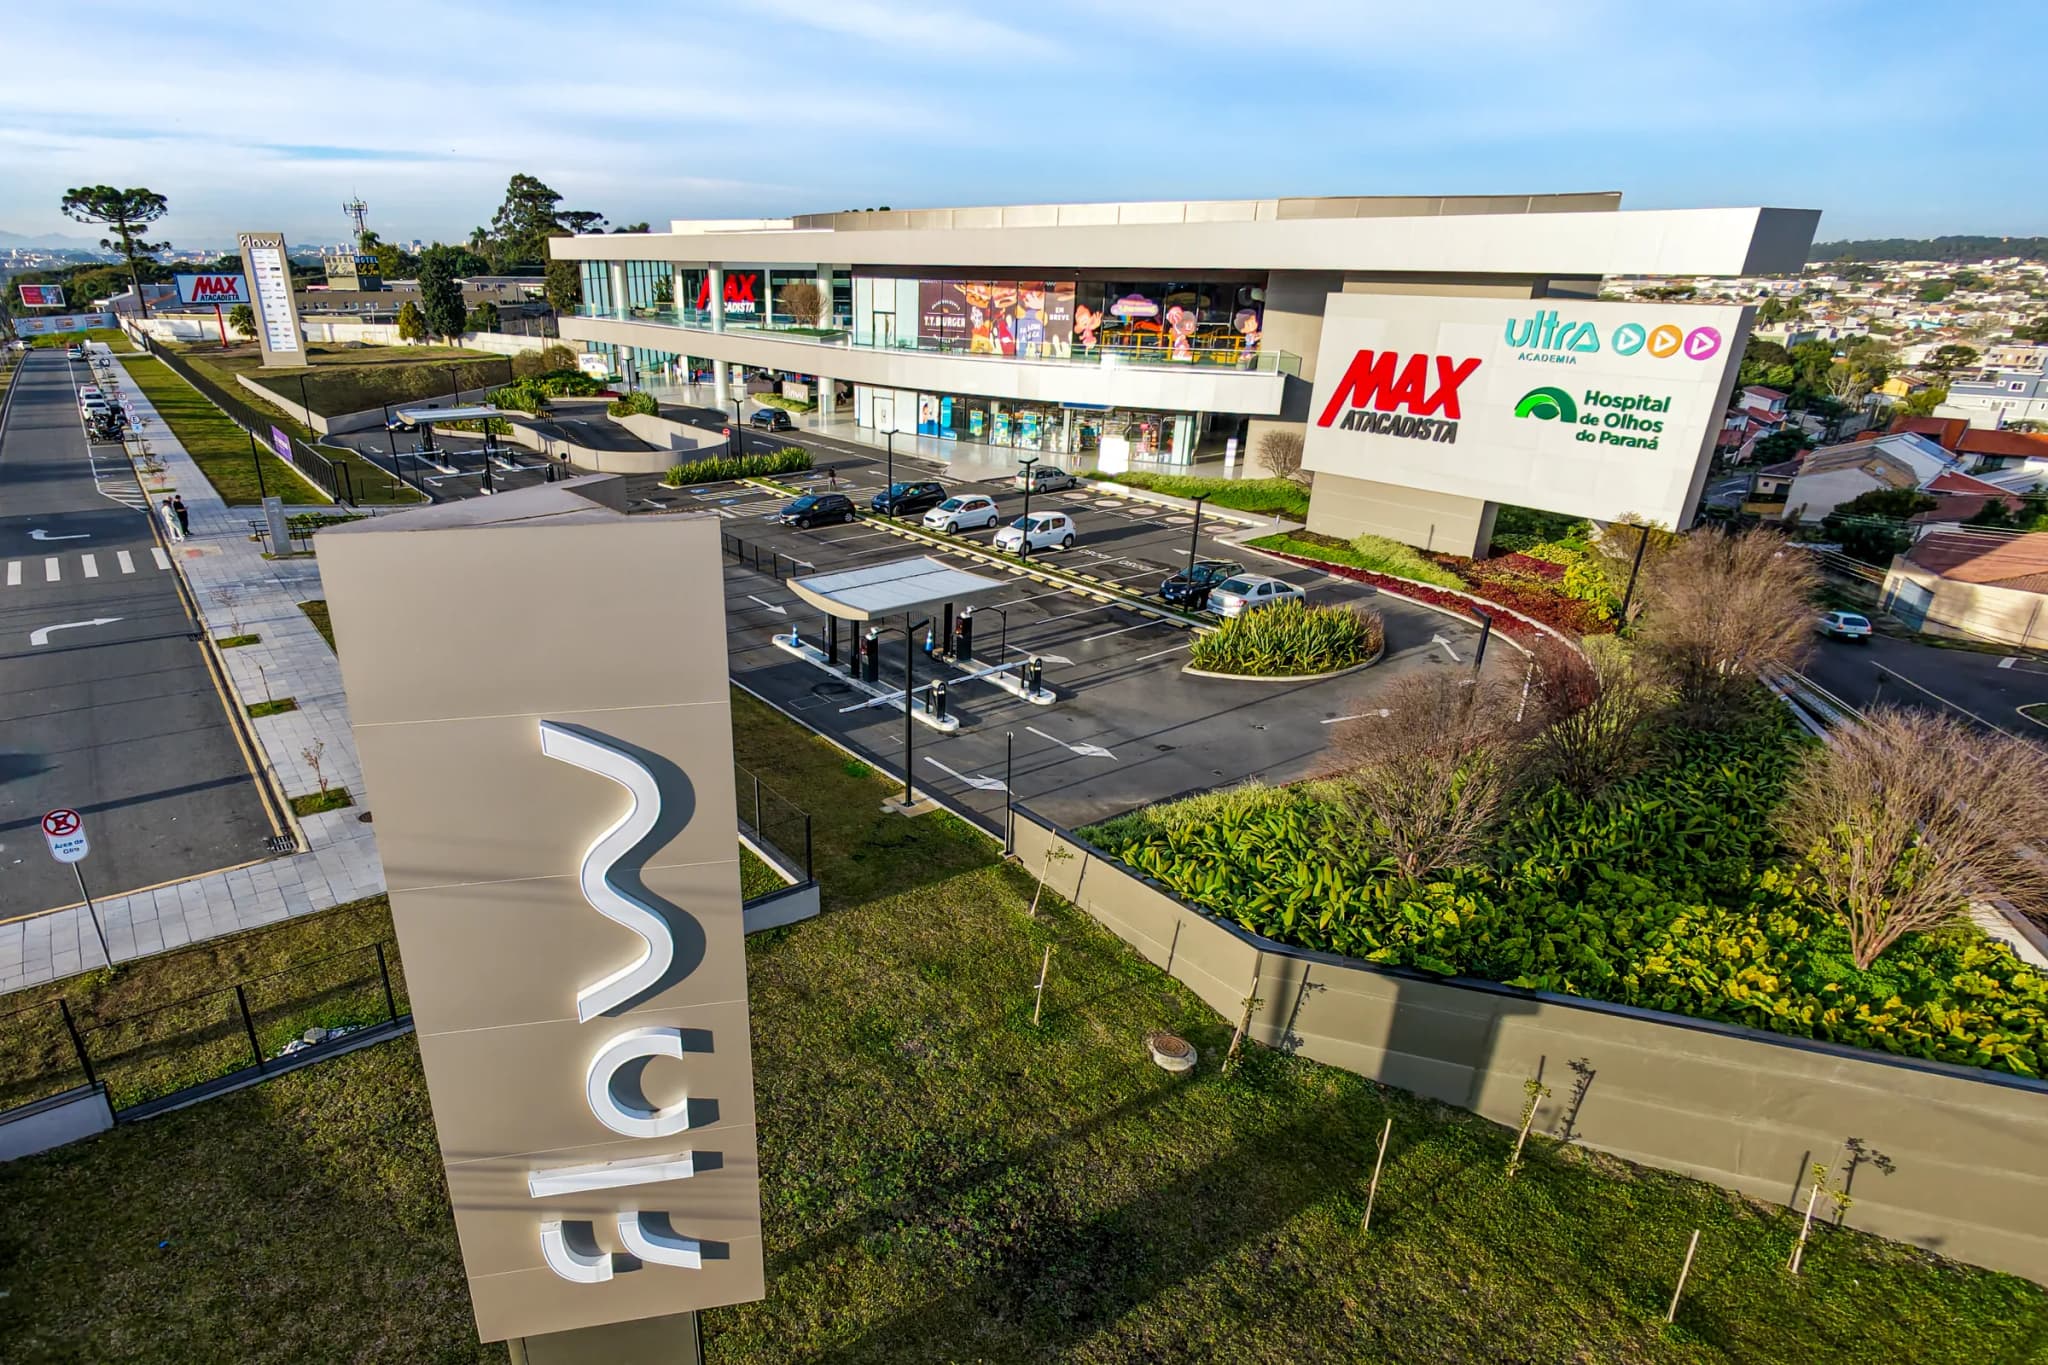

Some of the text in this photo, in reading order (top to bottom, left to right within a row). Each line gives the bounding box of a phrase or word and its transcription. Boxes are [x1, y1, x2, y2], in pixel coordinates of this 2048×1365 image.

[240, 234, 281, 247] flow
[191, 276, 238, 301] MAX
[1518, 352, 1577, 365] ACADEMIA
[1317, 349, 1482, 428] MAX
[1584, 389, 1672, 413] Hospital
[1340, 410, 1458, 444] ATACADISTA
[1579, 412, 1664, 433] de Olhos
[1575, 429, 1659, 450] do Paraná
